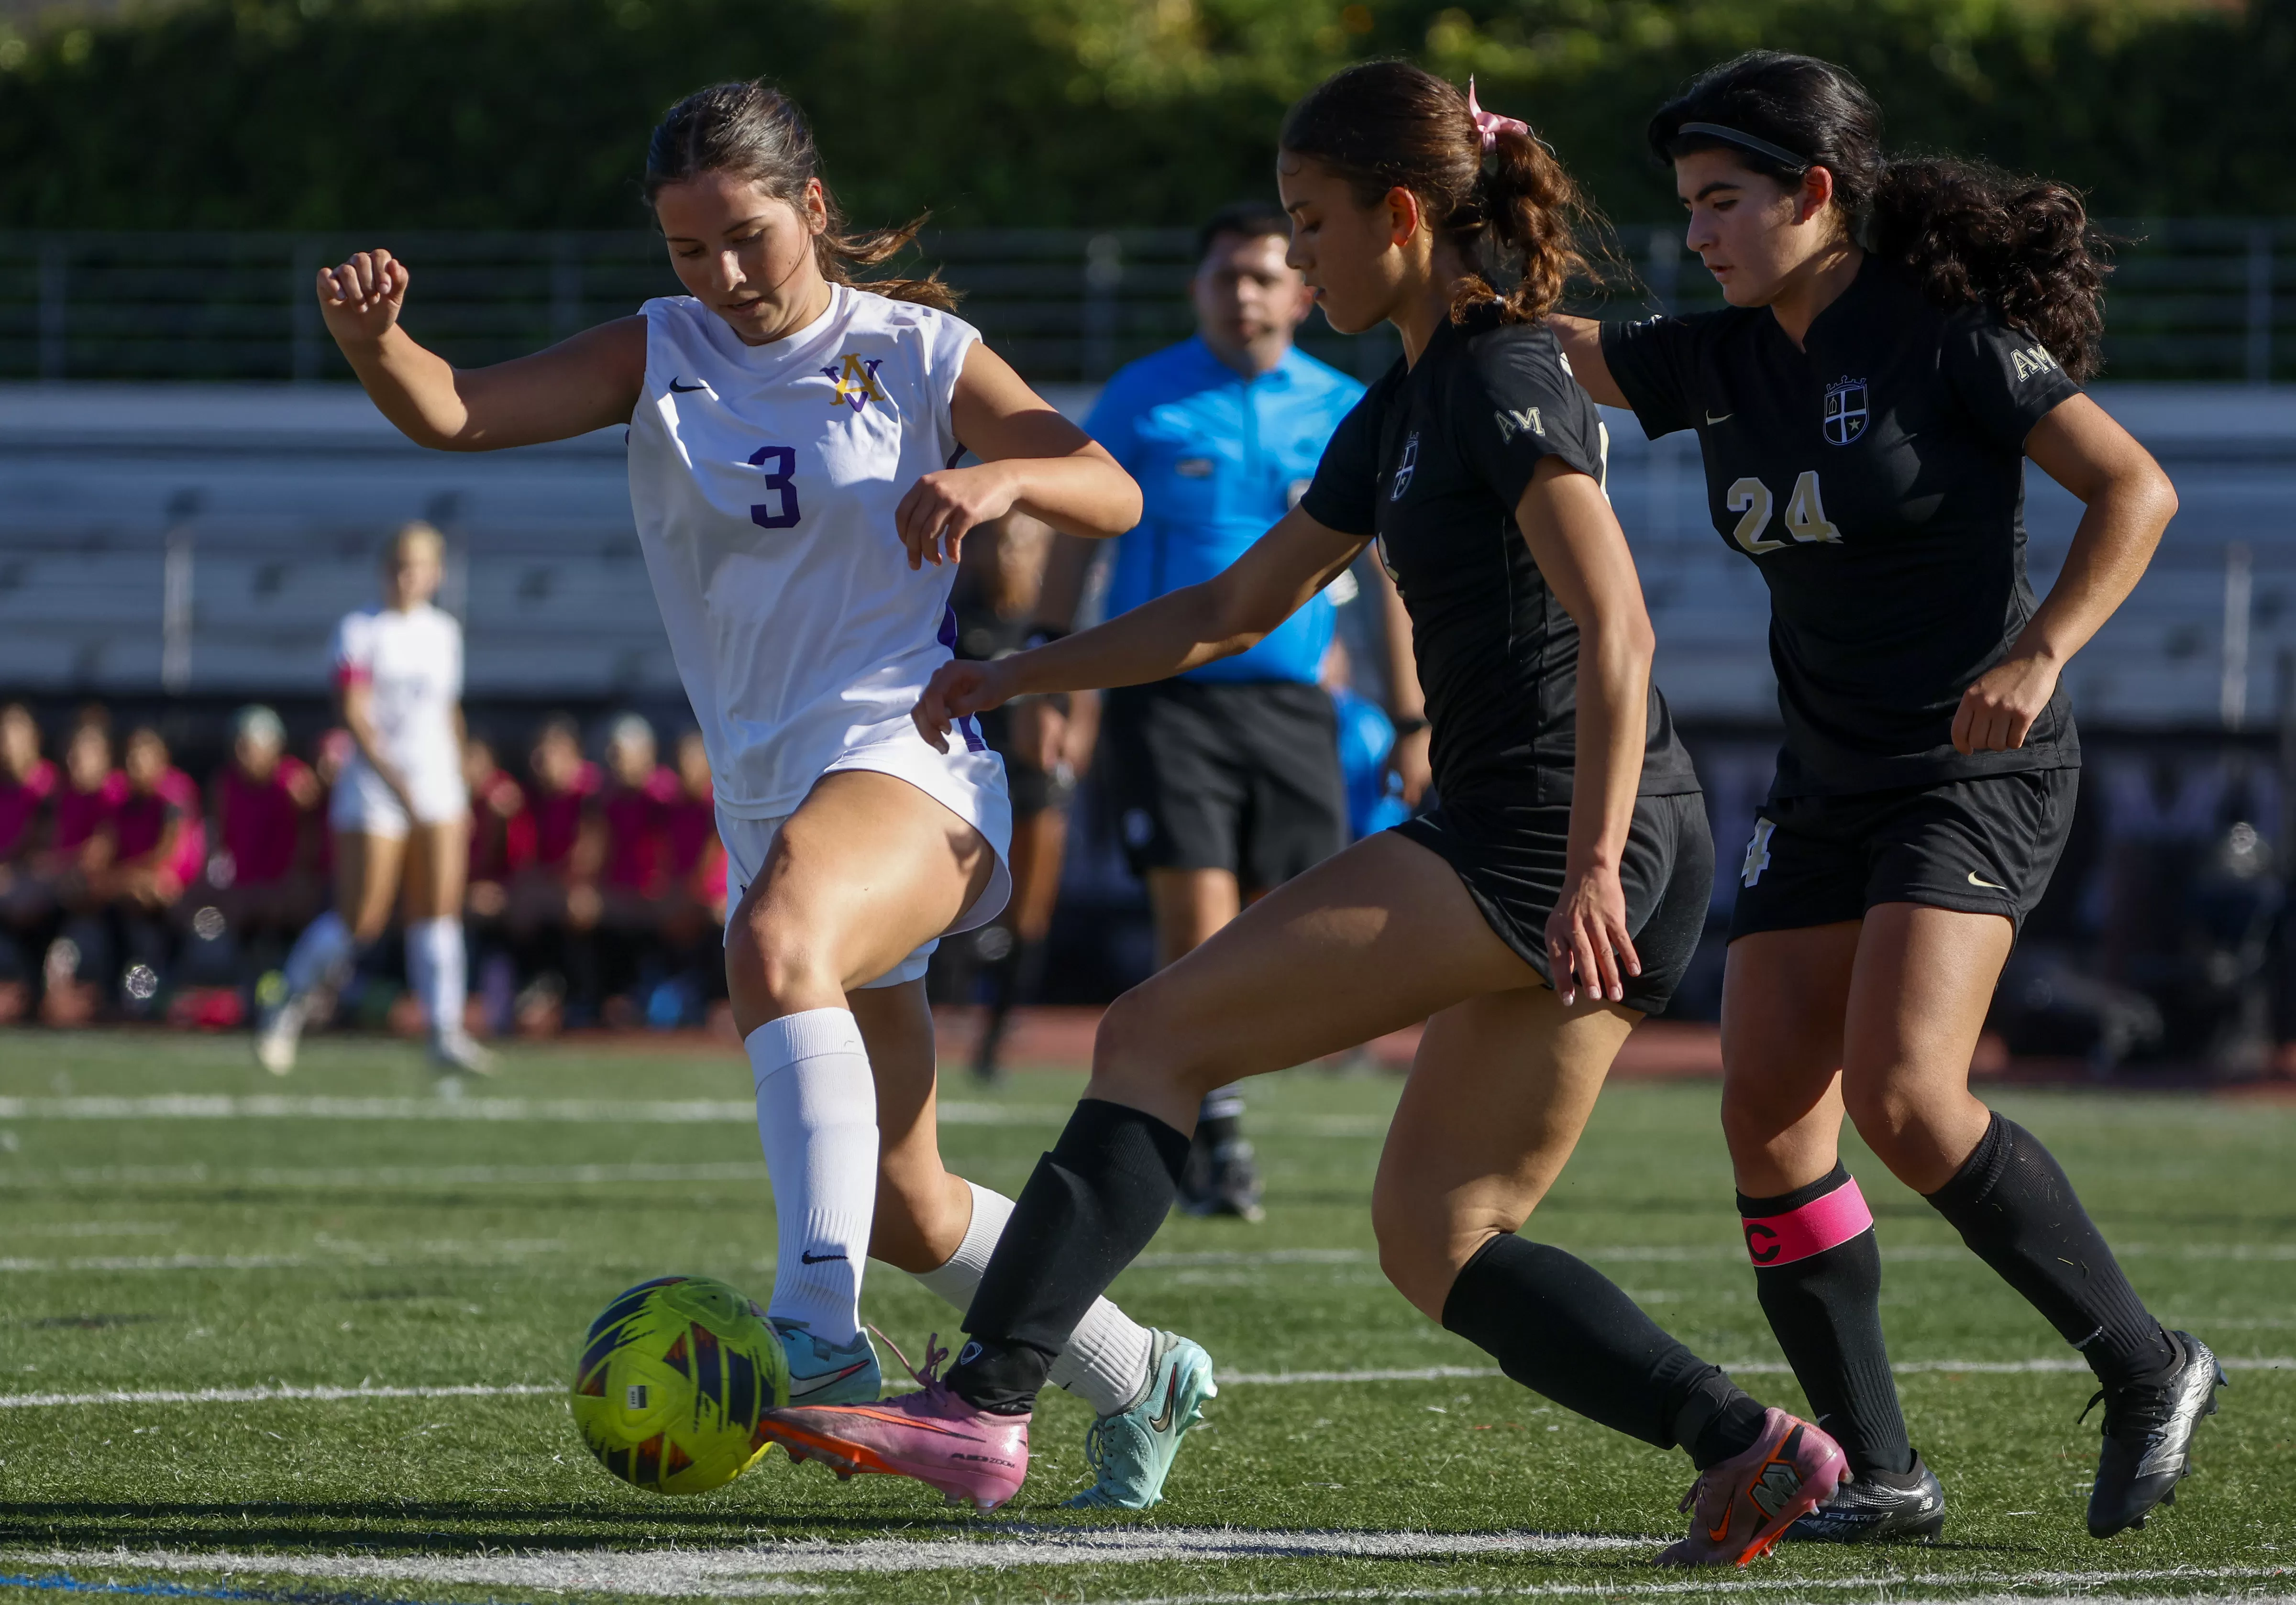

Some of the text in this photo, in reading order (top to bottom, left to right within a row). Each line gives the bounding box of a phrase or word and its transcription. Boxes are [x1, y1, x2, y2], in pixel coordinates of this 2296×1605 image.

[2010, 343, 2058, 382] AM
[1494, 407, 1545, 444] AM
[748, 446, 801, 528] 3
[1727, 470, 1844, 555] 24
[1746, 1224, 1781, 1263] C
